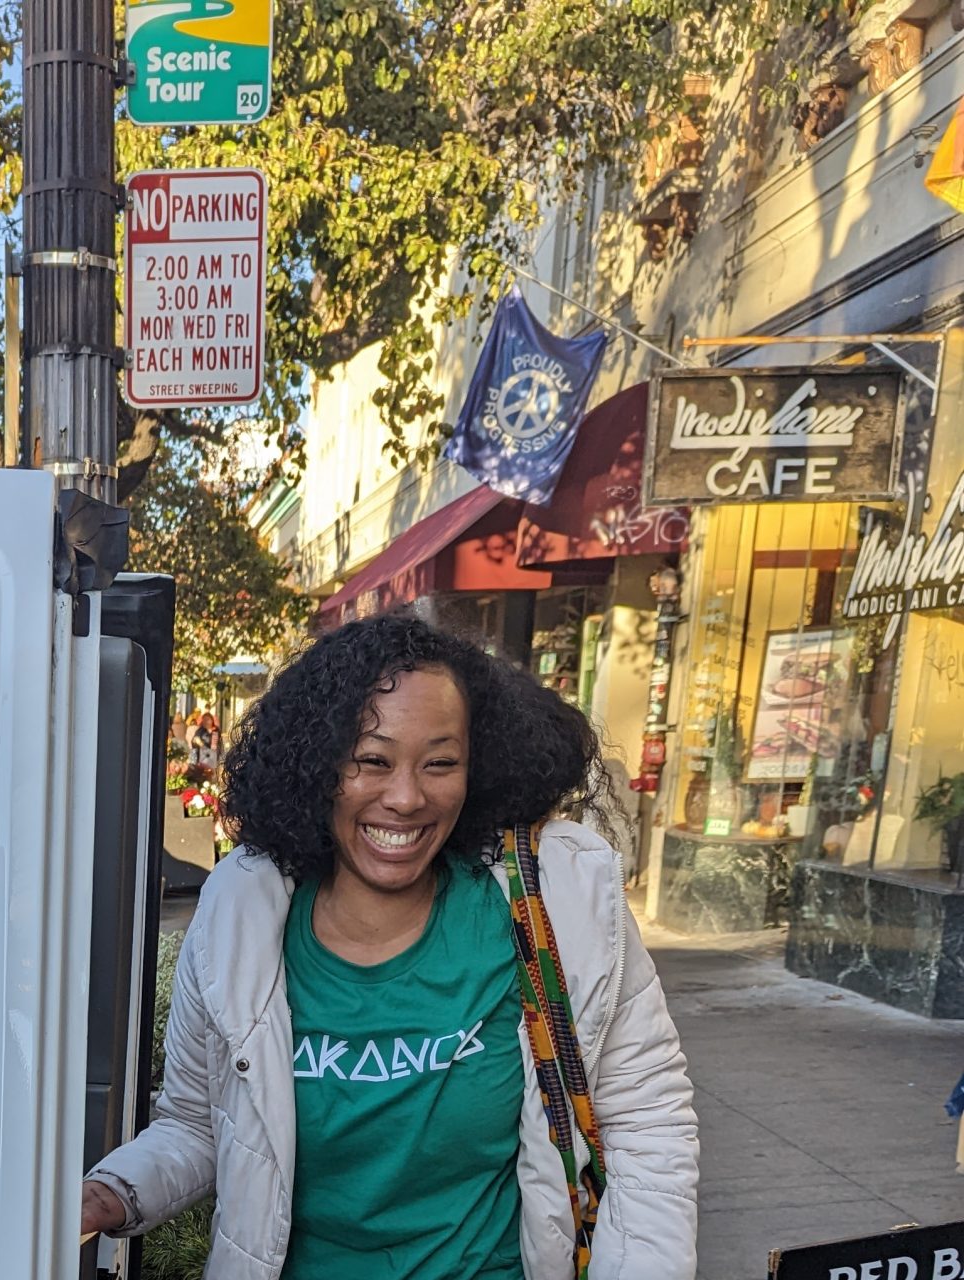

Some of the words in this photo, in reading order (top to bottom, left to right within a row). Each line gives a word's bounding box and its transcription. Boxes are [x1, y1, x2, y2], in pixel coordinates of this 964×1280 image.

[147, 43, 231, 72] Scenic
[145, 77, 205, 103] Tour
[240, 92, 260, 107] 20
[131, 188, 167, 232] NO
[172, 192, 258, 223] PARKING
[146, 256, 188, 280] 2:00
[197, 255, 223, 279] AM
[231, 253, 252, 278] TO
[156, 287, 198, 310] 3:00
[206, 285, 233, 309] AM
[140, 316, 174, 341] MON
[183, 315, 216, 340] WED
[225, 314, 250, 338] FRI
[137, 348, 182, 373] EACH
[192, 346, 253, 372] MONTH
[512, 354, 572, 394] PROUDLY
[149, 384, 185, 396] STREET
[188, 383, 238, 395] SWEEPING
[482, 387, 567, 453] PROGRESSIVE
[706, 457, 838, 496] CAFE
[847, 587, 939, 618] MODIGLANI
